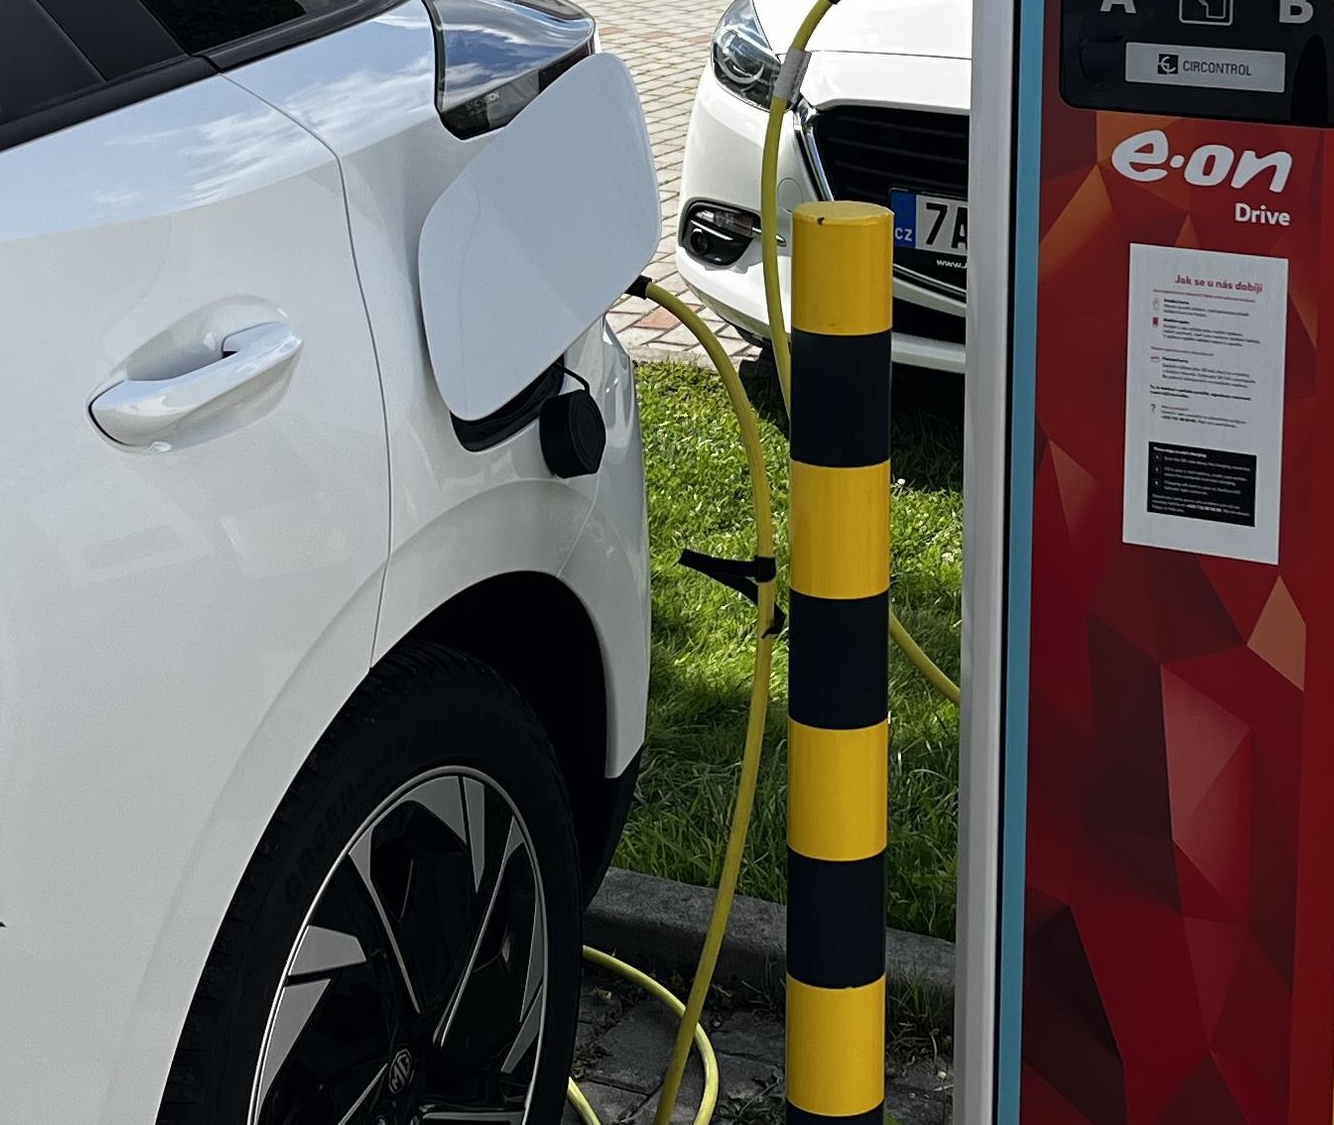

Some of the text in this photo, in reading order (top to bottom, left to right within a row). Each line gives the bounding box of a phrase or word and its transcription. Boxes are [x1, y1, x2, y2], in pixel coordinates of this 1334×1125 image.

[1182, 60, 1252, 76] CIRCONTROL
[1235, 203, 1291, 226] Drive
[894, 227, 913, 241] CZ
[1175, 275, 1192, 285] Jak
[1194, 279, 1205, 287] se
